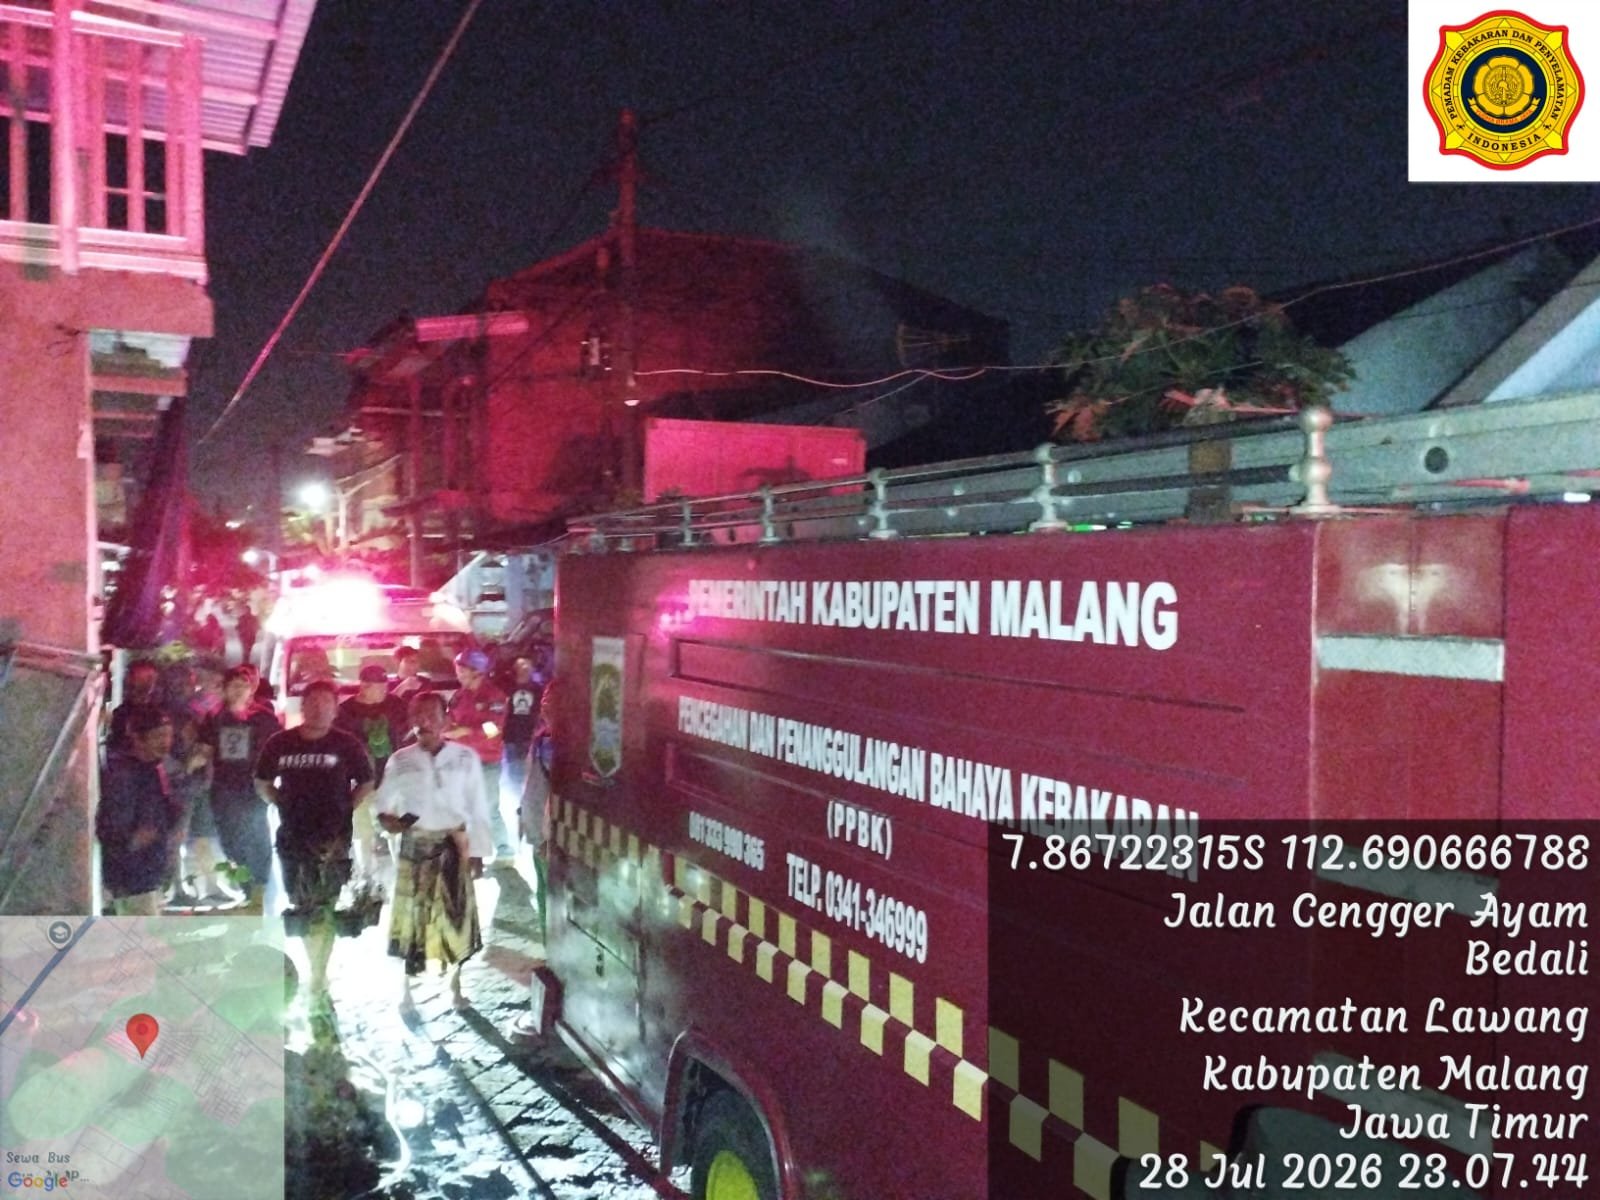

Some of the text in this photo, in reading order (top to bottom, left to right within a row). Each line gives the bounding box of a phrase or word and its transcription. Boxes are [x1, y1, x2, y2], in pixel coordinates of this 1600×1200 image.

[688, 580, 1178, 650] PEMERINTAH KABUPATEN MALANG
[777, 717, 926, 802] PENANGGULANGAN
[930, 752, 1014, 828] BAHAYA
[827, 800, 892, 860] (PPBK)
[786, 852, 928, 964] TELP. 0341-346999
